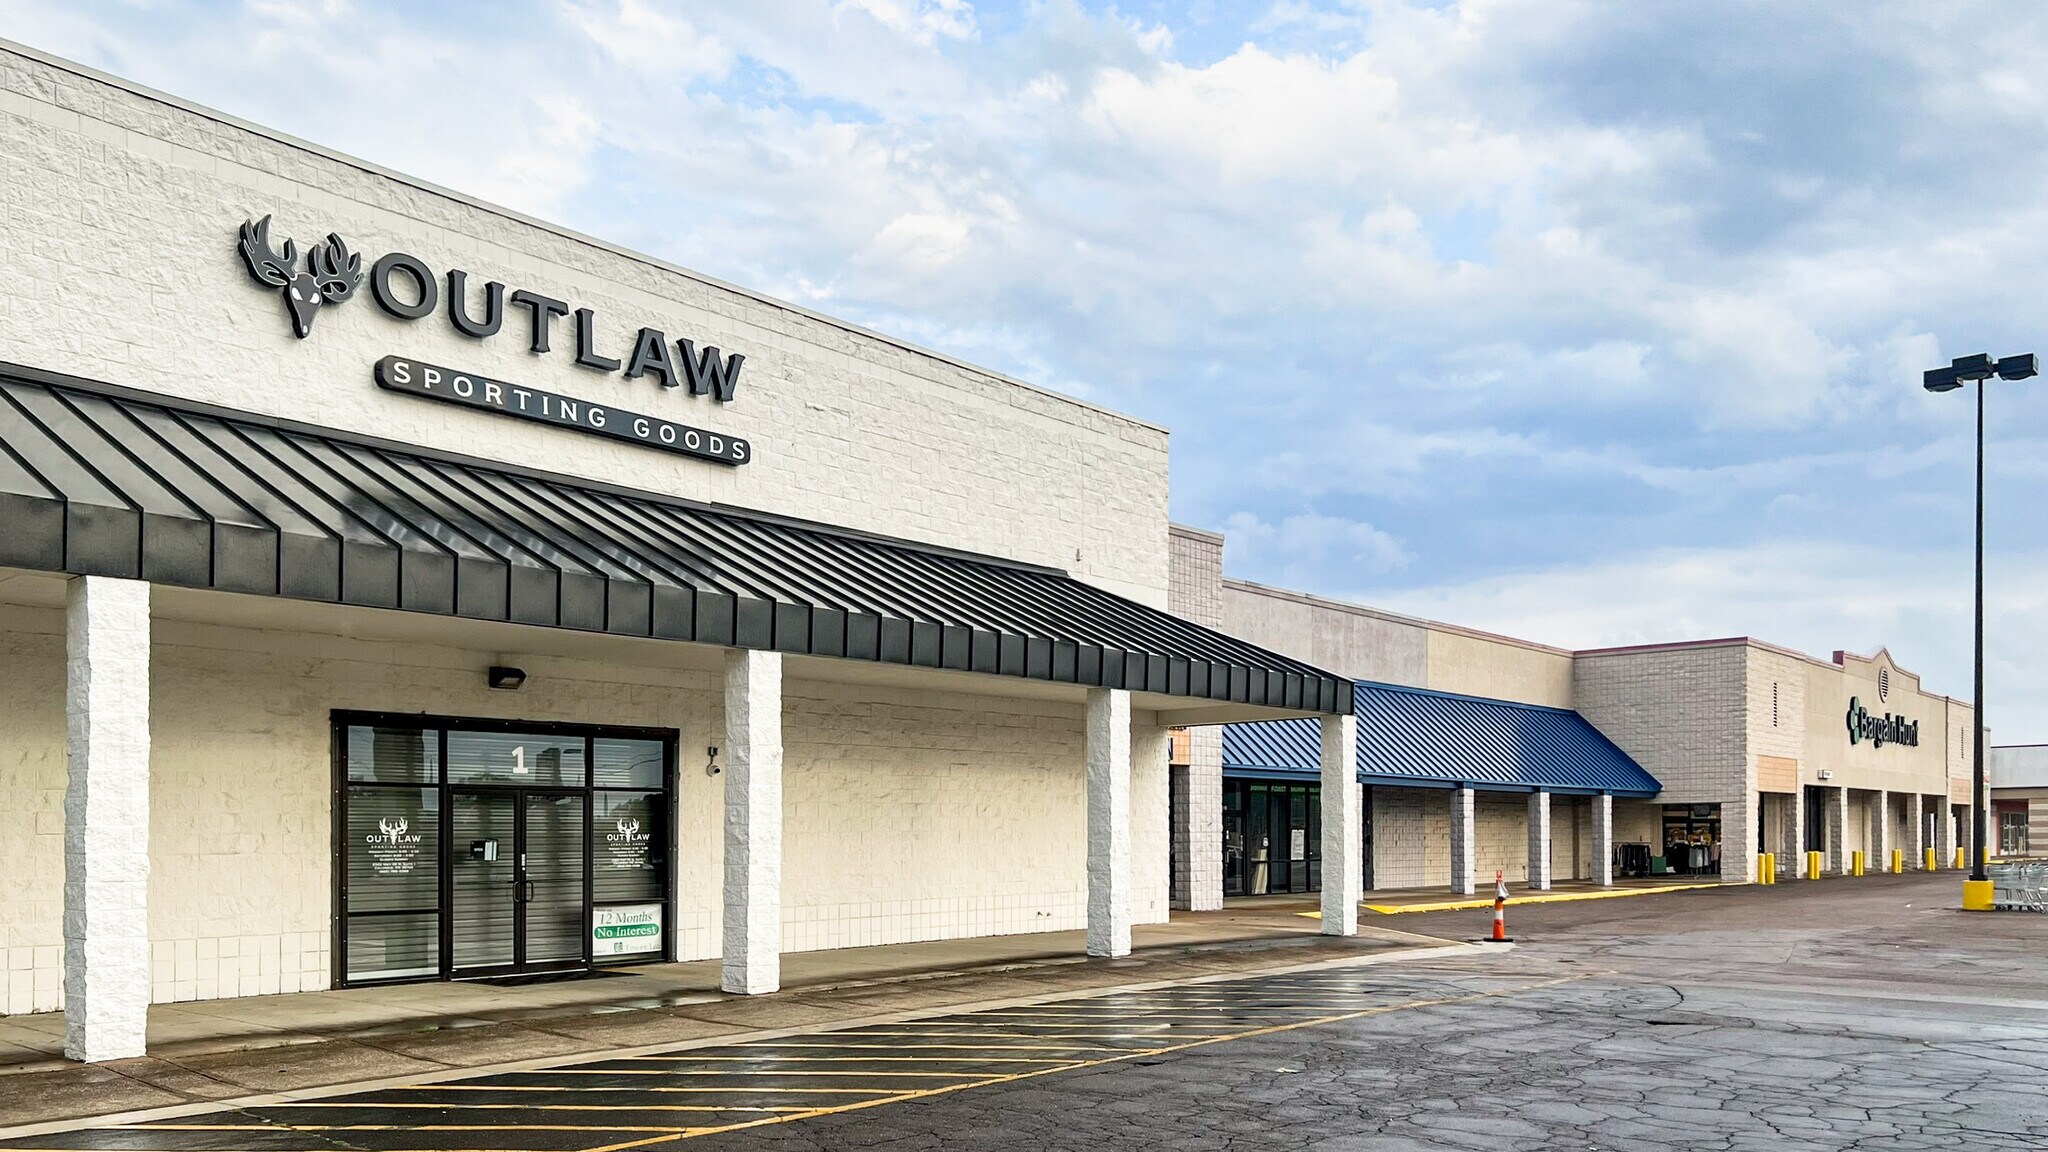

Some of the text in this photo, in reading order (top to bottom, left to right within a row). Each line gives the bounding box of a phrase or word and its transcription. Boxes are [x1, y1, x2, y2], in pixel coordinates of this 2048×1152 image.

[370, 252, 746, 402] OUTLAW
[393, 361, 746, 460] SPORTING GOODS
[1858, 706, 1919, 748] Bargain Hunt
[511, 745, 528, 774] 1
[597, 926, 657, 938] No Interest
[600, 911, 653, 925] 12 Months
